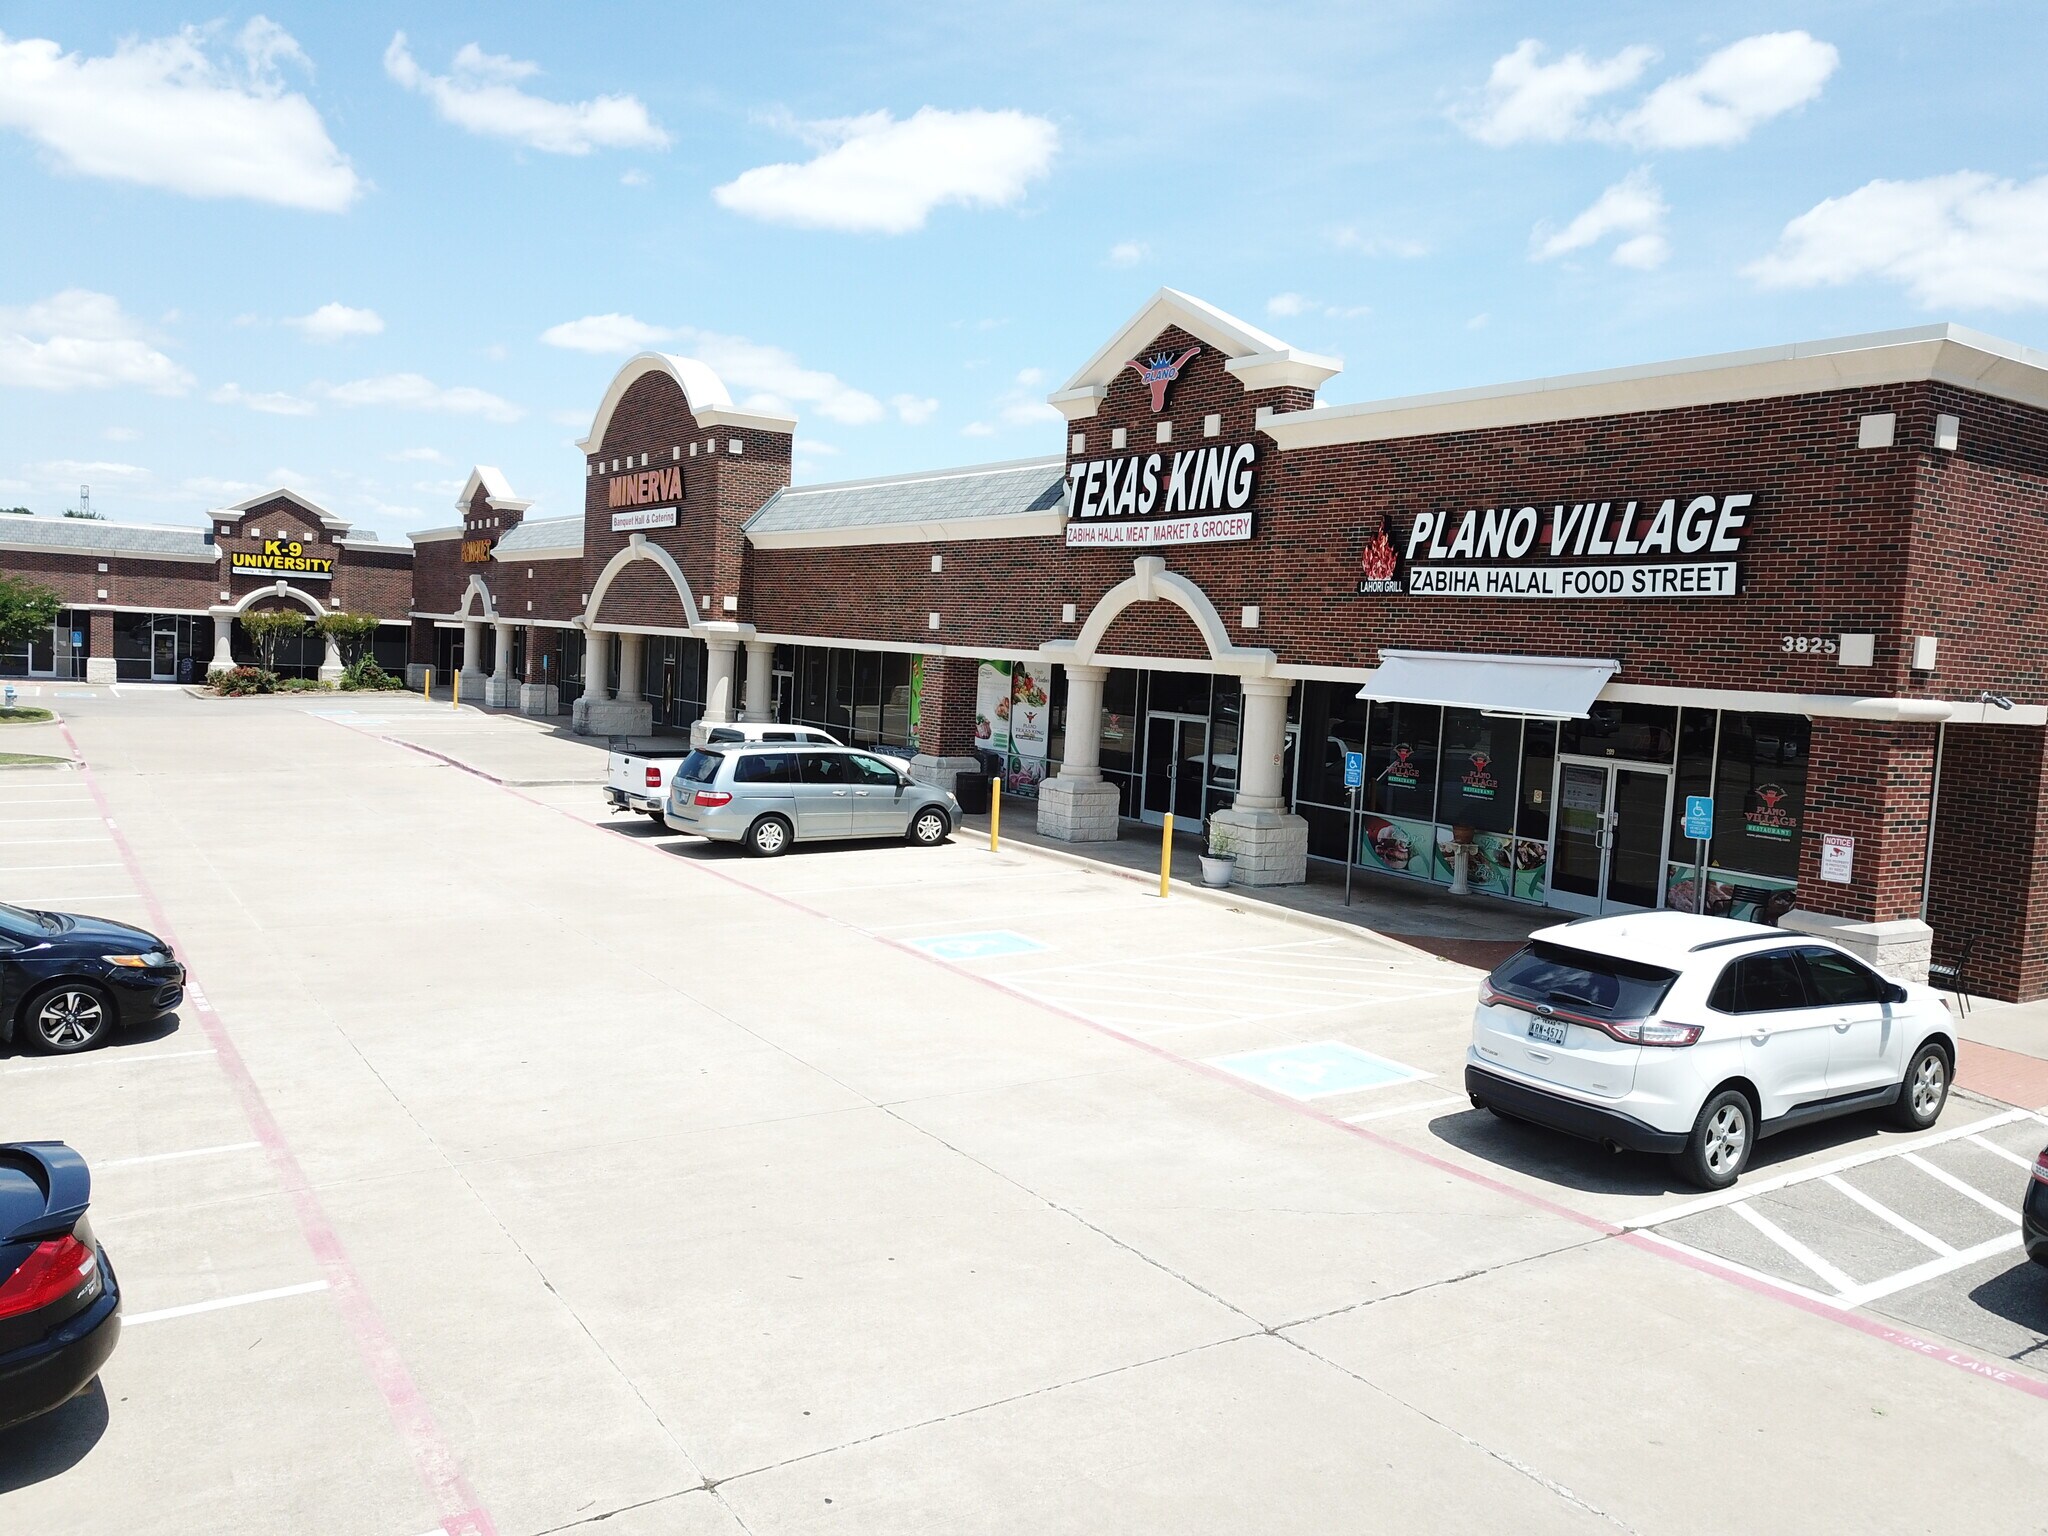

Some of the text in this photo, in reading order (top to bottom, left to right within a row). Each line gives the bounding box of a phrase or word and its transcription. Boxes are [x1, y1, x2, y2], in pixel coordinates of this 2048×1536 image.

[1144, 367, 1176, 381] PLANO
[608, 466, 682, 507] MINERVA
[1068, 443, 1255, 518] TEXAS KING
[614, 512, 674, 528] Banquet Hall & Catering
[1405, 494, 1753, 559] PLANO VILLAGE
[1067, 518, 1250, 542] ZABIHA HALAL MEAT MARKET & GROCERY
[265, 540, 302, 557] K-9
[232, 553, 332, 572] UNIVERSITY
[1360, 581, 1402, 593] LAHORI GRILL
[1411, 567, 1729, 594] ZABIHA HALAL FOOD STREET
[1781, 636, 1837, 654] 3825
[1387, 766, 1420, 778] VILLAGE
[1470, 771, 1491, 779] PLANO
[1461, 776, 1497, 788] VILLAGE
[1756, 806, 1786, 816] PLANO
[1744, 812, 1797, 827] VILLAGE
[1748, 825, 1791, 836] RESTAURANT
[1826, 837, 1851, 846] NOTICE
[1946, 1355, 2015, 1382] LANE
